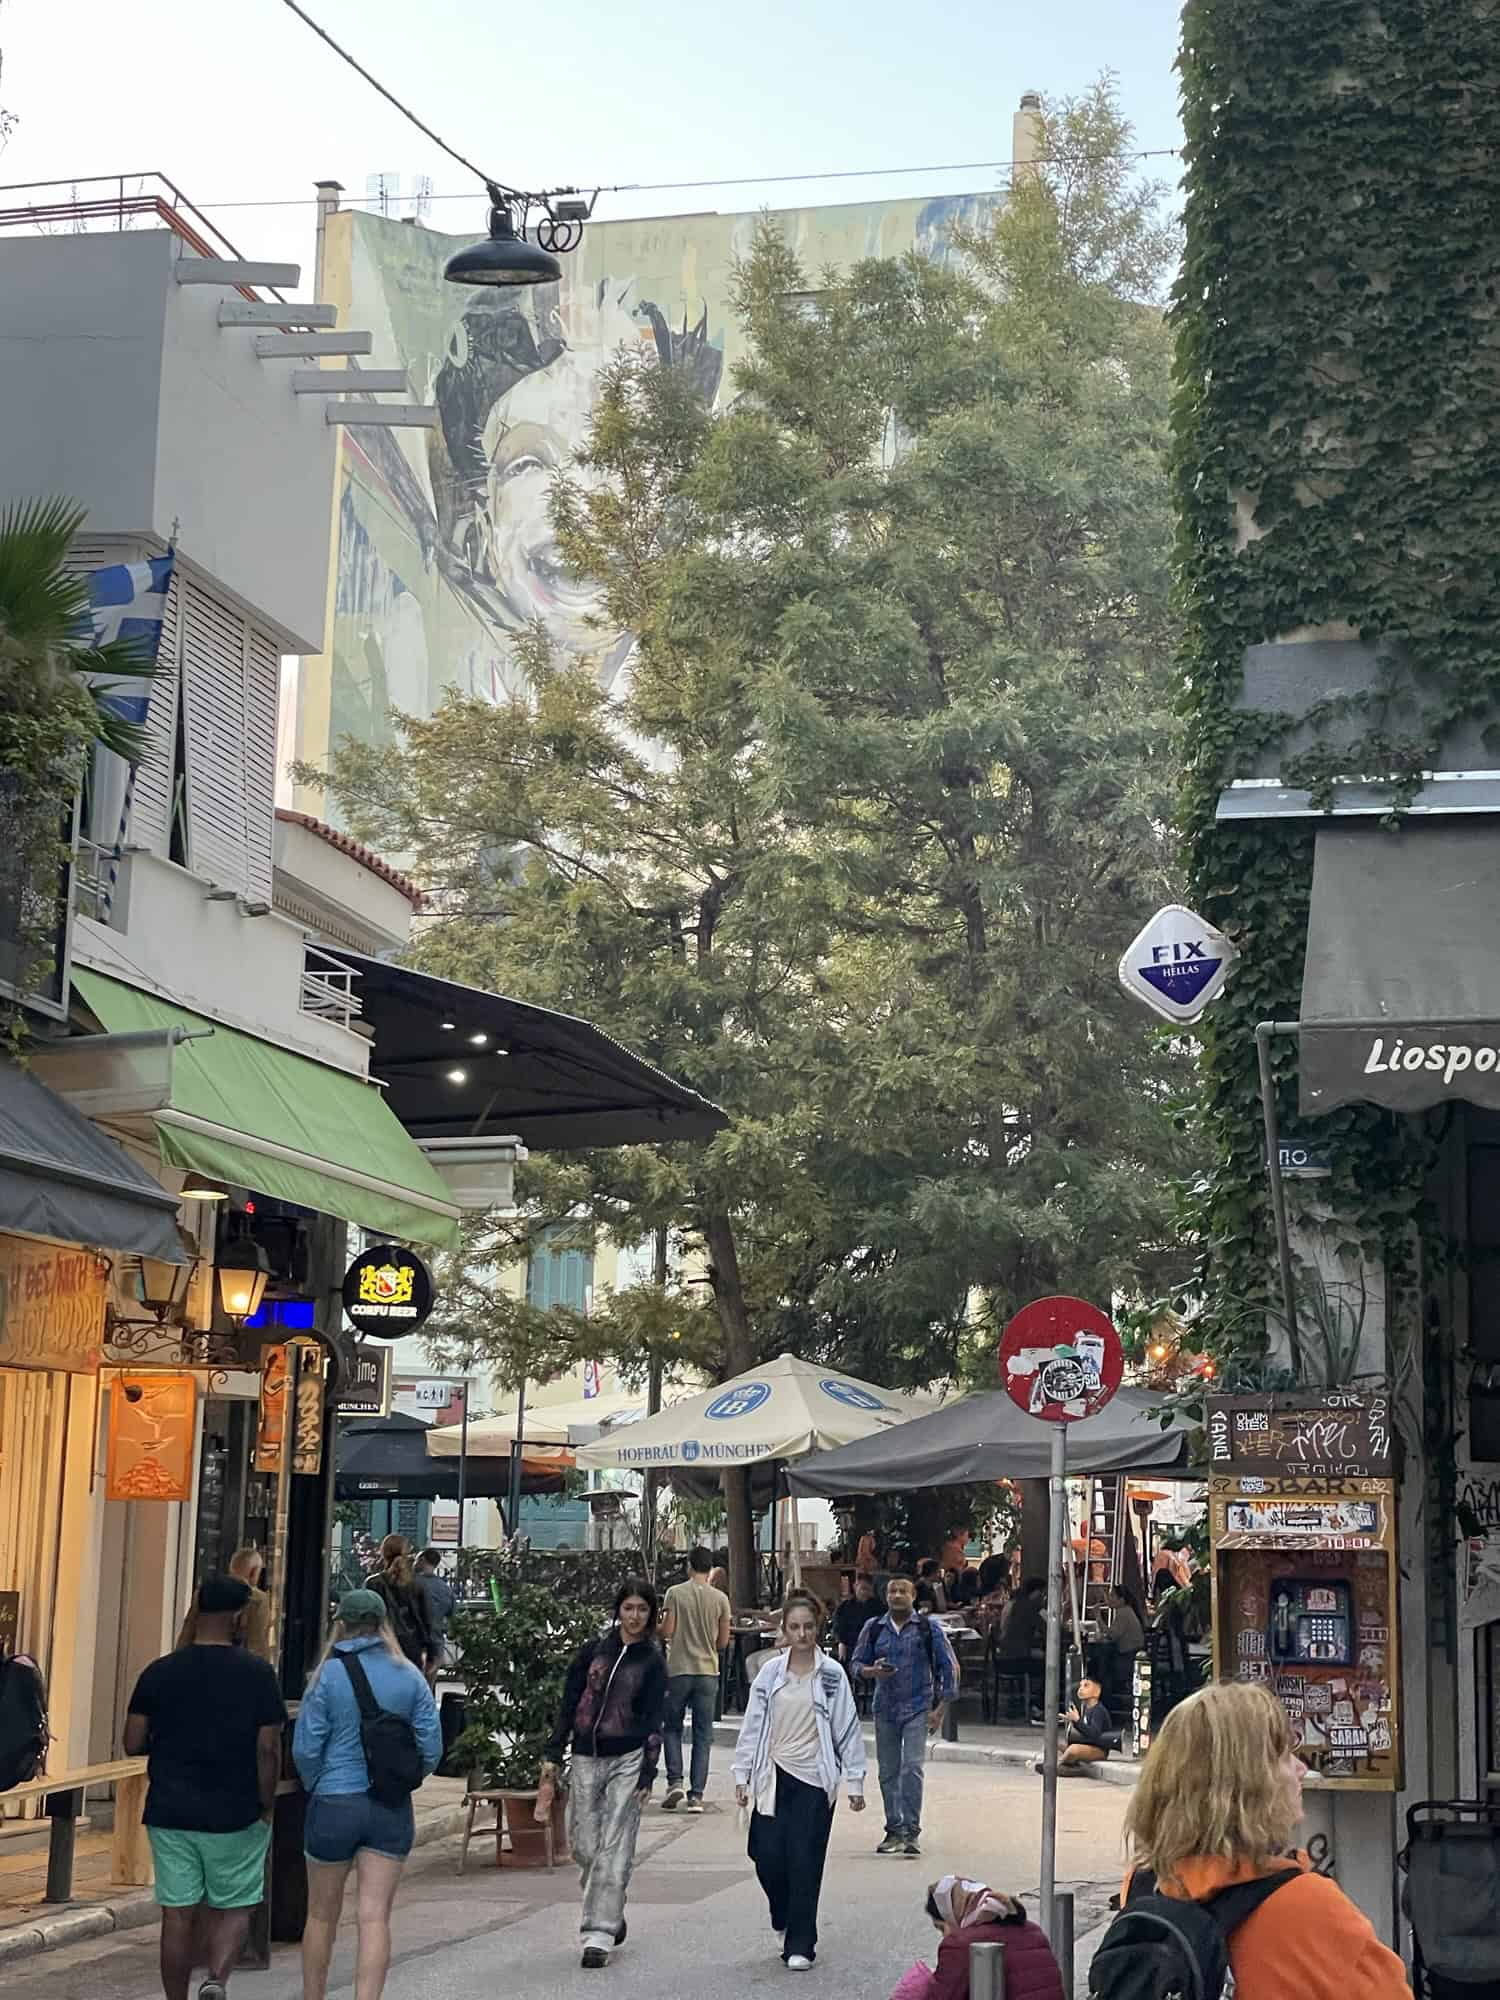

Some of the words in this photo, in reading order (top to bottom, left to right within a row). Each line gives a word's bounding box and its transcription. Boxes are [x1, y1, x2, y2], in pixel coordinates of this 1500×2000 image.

[1152, 941, 1206, 964] FIX
[1162, 965, 1200, 977] HELLAS
[701, 1441, 775, 1459] MÜNCHEN
